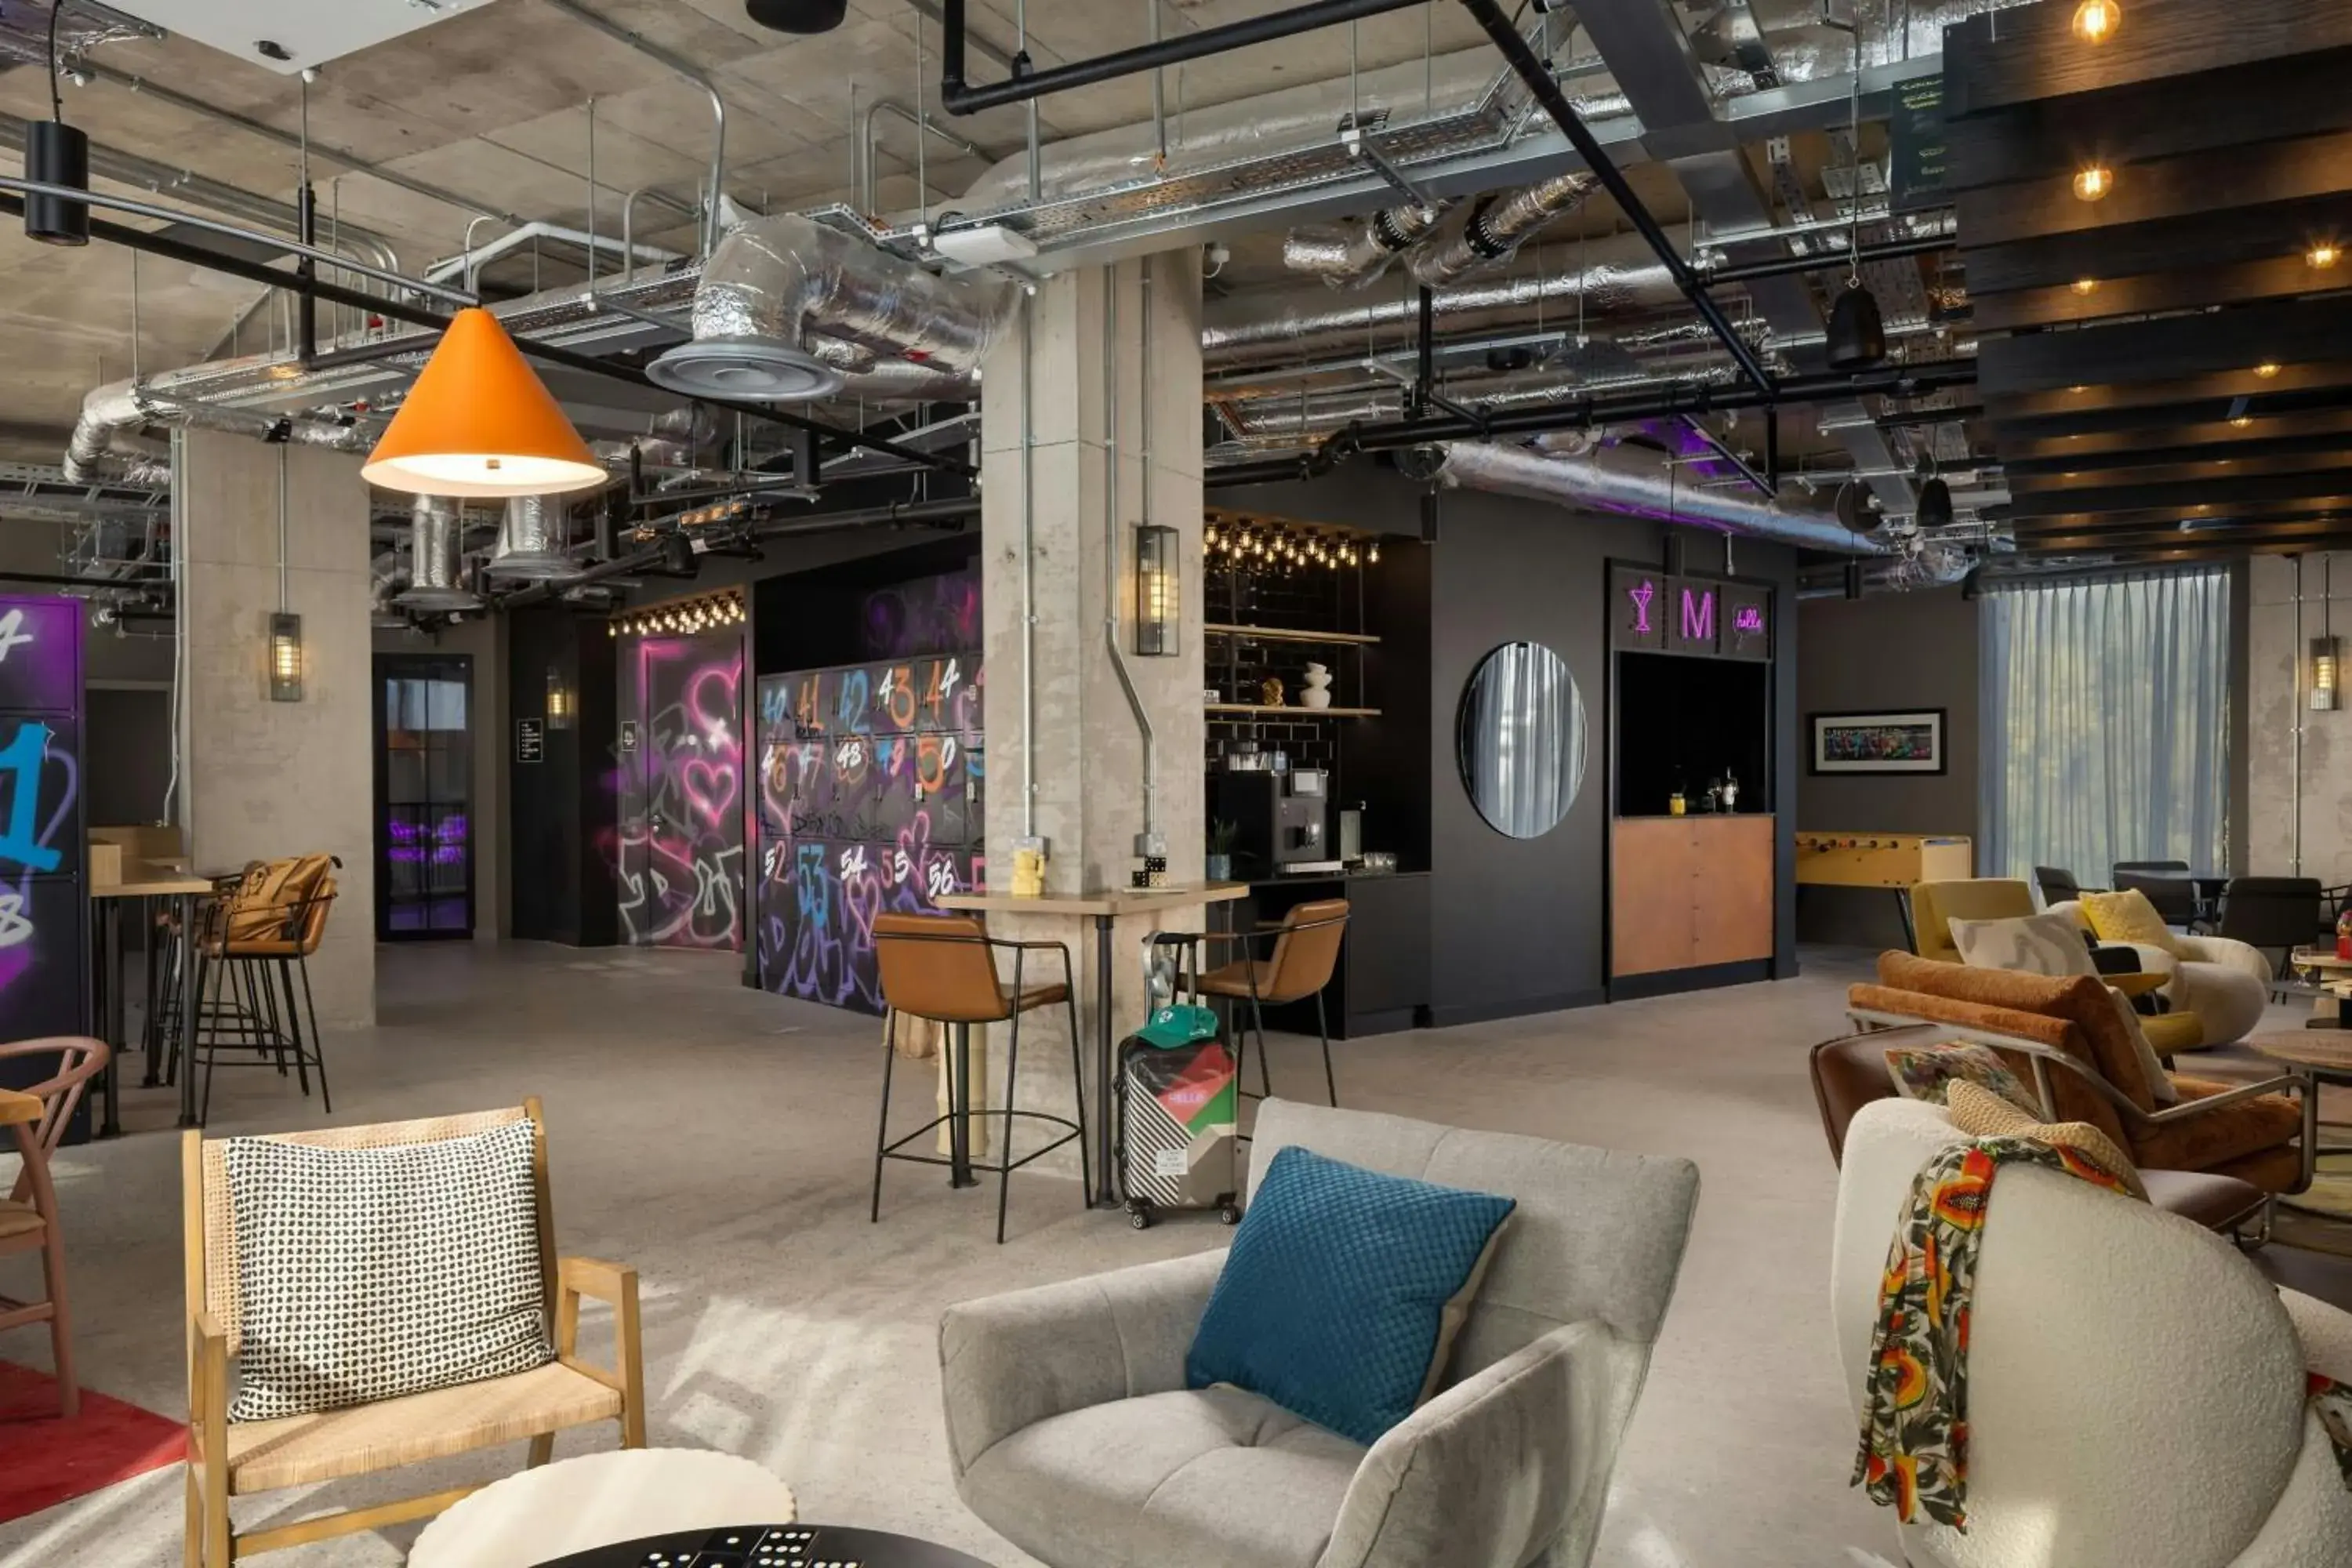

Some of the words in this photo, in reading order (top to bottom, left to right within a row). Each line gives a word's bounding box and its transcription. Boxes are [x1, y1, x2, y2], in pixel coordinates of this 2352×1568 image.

[1682, 589, 1712, 640] M
[797, 673, 825, 731] 41
[839, 668, 870, 733] 42
[879, 666, 915, 728] 43
[926, 658, 960, 728] 44
[761, 741, 787, 793] 46
[837, 741, 862, 769] 48
[875, 737, 906, 778] 49
[918, 735, 956, 793] 50
[764, 840, 790, 884] 52
[797, 844, 829, 928] 53
[840, 844, 868, 883] 54
[880, 849, 909, 889] 55
[929, 858, 954, 898] 56
